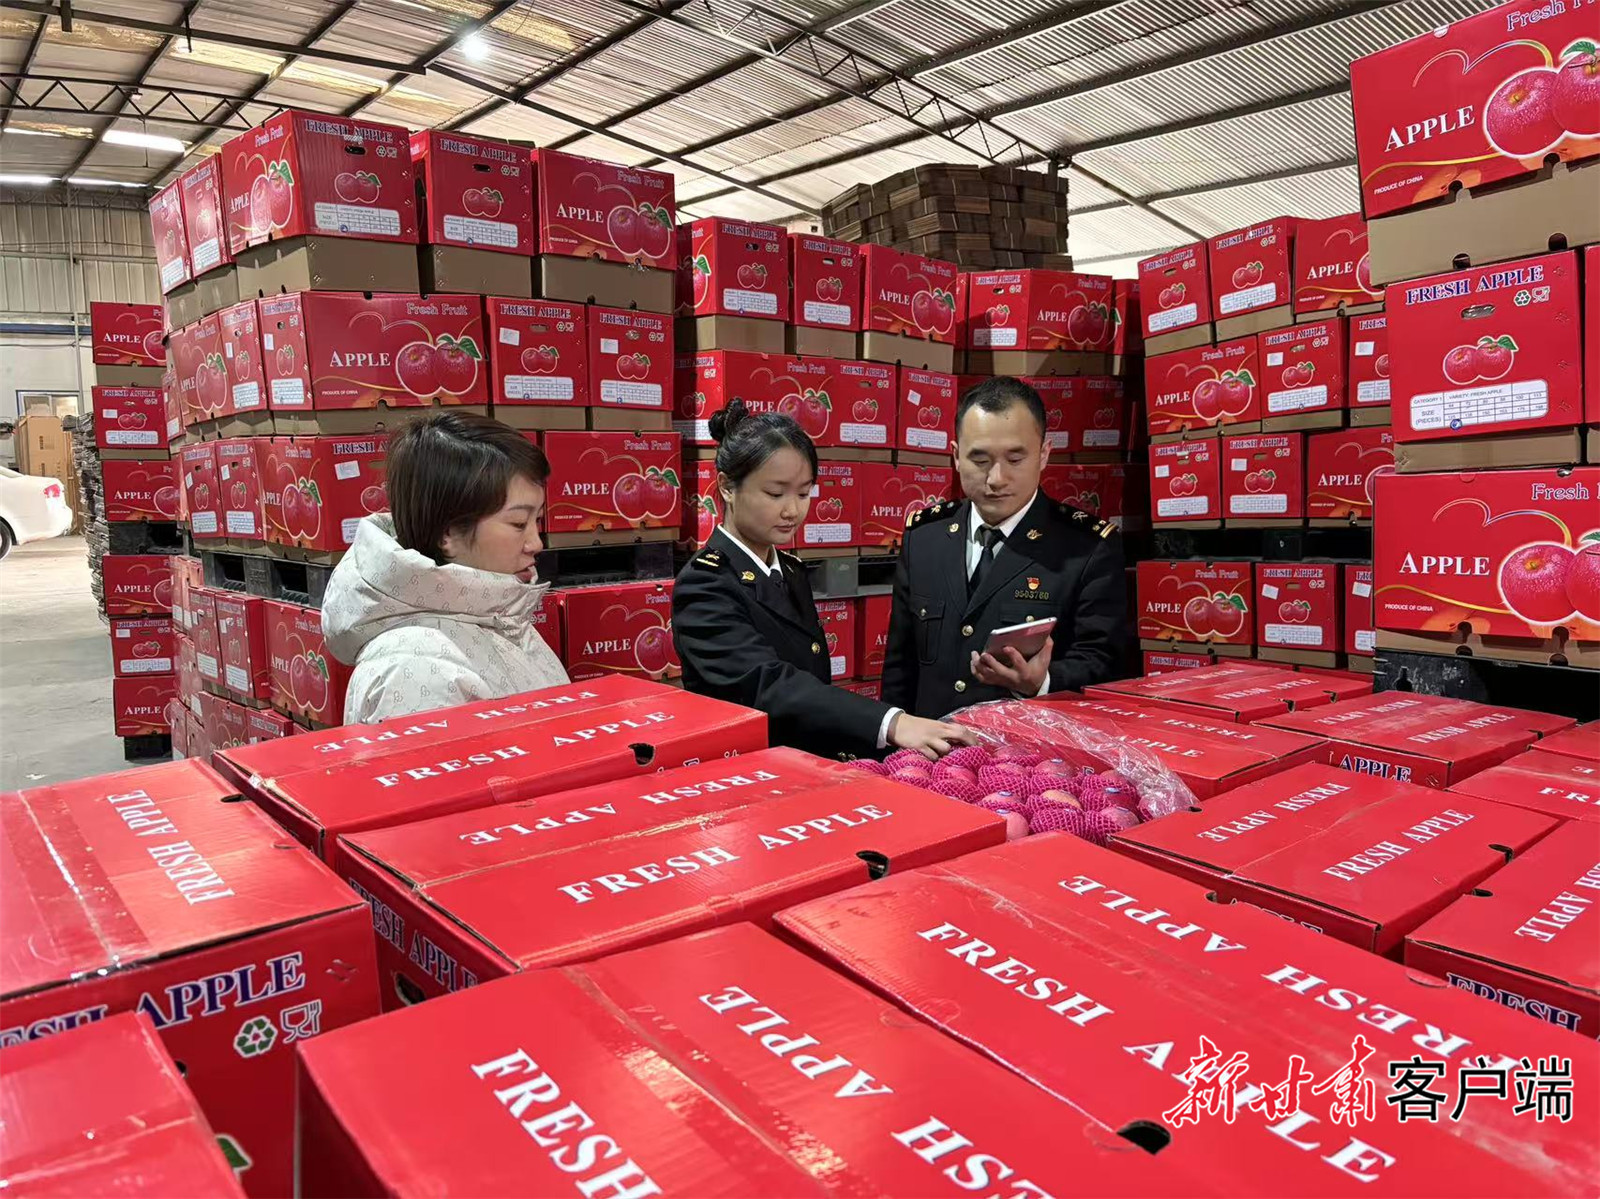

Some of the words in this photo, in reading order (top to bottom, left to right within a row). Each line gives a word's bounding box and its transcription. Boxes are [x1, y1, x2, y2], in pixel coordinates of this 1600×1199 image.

[1506, 0, 1566, 32] Fresh
[305, 119, 348, 136] FRESH
[1384, 105, 1476, 152] APPLE
[440, 139, 478, 155] FRESH
[481, 146, 517, 162] APPLE
[1374, 181, 1397, 195] PRODUCE
[1398, 180, 1405, 188] OF
[1406, 175, 1423, 187] CHINA
[230, 192, 250, 214] APPLE
[556, 204, 604, 223] APPLE
[1306, 262, 1353, 280] APPLE
[1405, 278, 1470, 306] FRESH
[1475, 265, 1544, 292] APPLE
[880, 288, 910, 306] APPLE
[500, 304, 536, 318] FRESH
[539, 306, 571, 319] APPLE
[1037, 309, 1067, 322] APPLE
[1359, 318, 1387, 330] FRES
[103, 332, 141, 344] APPLE
[330, 350, 390, 367] APPLE
[744, 400, 774, 414] PPLE
[1155, 391, 1191, 406] APPLE
[334, 442, 374, 454] FRESH
[562, 481, 610, 496] APPLE
[1318, 474, 1362, 486] APPLE
[1531, 482, 1589, 500] Fresh
[114, 490, 151, 500] APPLE
[871, 504, 902, 516] APPLE
[1398, 552, 1490, 576] APPLE
[114, 584, 151, 594] APPLE
[1146, 601, 1181, 613] APPLE
[582, 638, 631, 656] APPLE
[124, 705, 160, 714] APPLE
[475, 690, 598, 720] FRESH
[313, 720, 448, 752] APPLE
[1163, 719, 1256, 739] FRESH
[1407, 725, 1467, 743] FRESH
[1463, 712, 1515, 728] APPLE
[373, 744, 529, 788] FRESH
[553, 712, 675, 746] APPLE
[1339, 753, 1412, 783] APPLE
[638, 770, 780, 805] FRESH
[1274, 782, 1351, 812] FRESH
[106, 790, 178, 837] APPLE
[459, 803, 617, 846] APPLE
[1197, 810, 1278, 842] APPLE
[558, 846, 740, 903] FRESH
[756, 804, 893, 851] APPLE
[1322, 840, 1412, 881] FRESH
[1402, 809, 1476, 843] APPLE
[147, 840, 235, 906] FRESH
[1058, 875, 1247, 952] APPLE
[1514, 891, 1593, 943] APPLE
[916, 922, 1114, 1026] FRESH
[137, 952, 305, 1029] APPLE
[698, 986, 894, 1098] APPLE
[470, 1048, 663, 1199] FRESH
